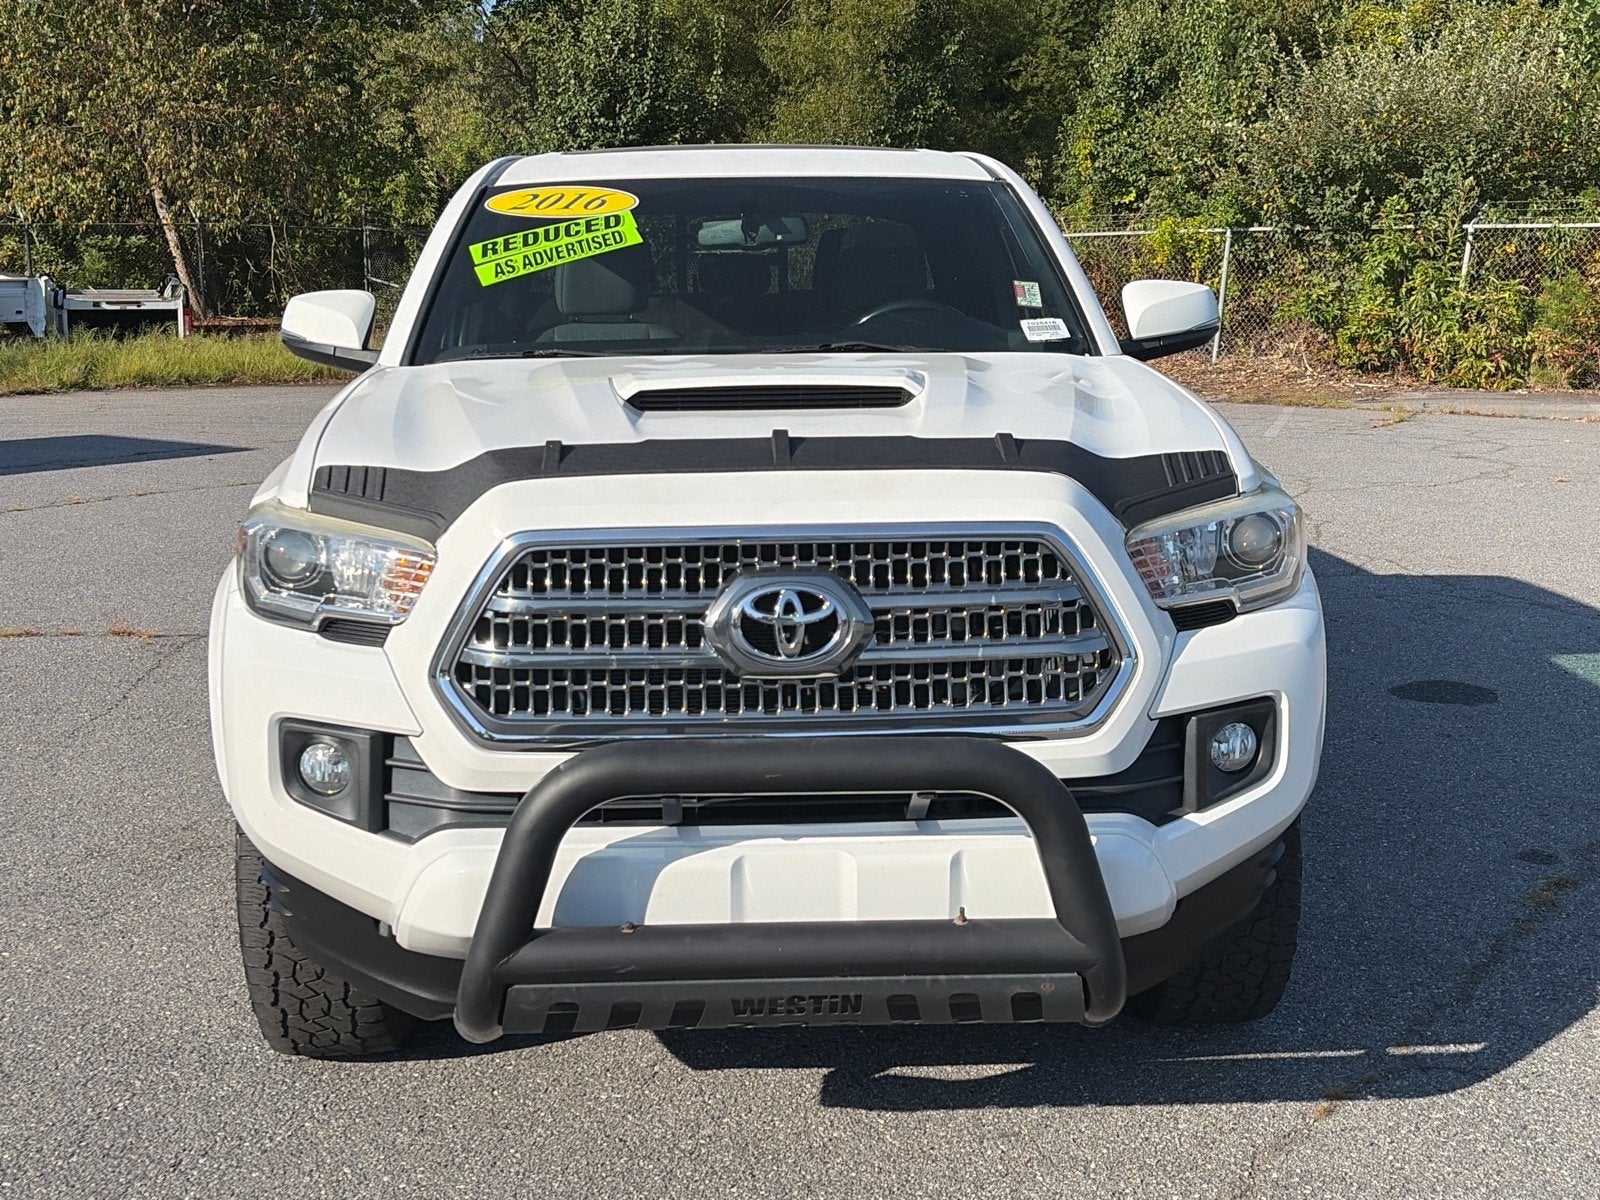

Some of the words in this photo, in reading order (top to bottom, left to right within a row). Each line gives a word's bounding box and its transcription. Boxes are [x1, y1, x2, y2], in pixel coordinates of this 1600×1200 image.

[508, 192, 615, 211] 2016
[481, 213, 624, 259] REDUCED
[494, 258, 517, 279] AS
[522, 230, 625, 271] ADVERTISED
